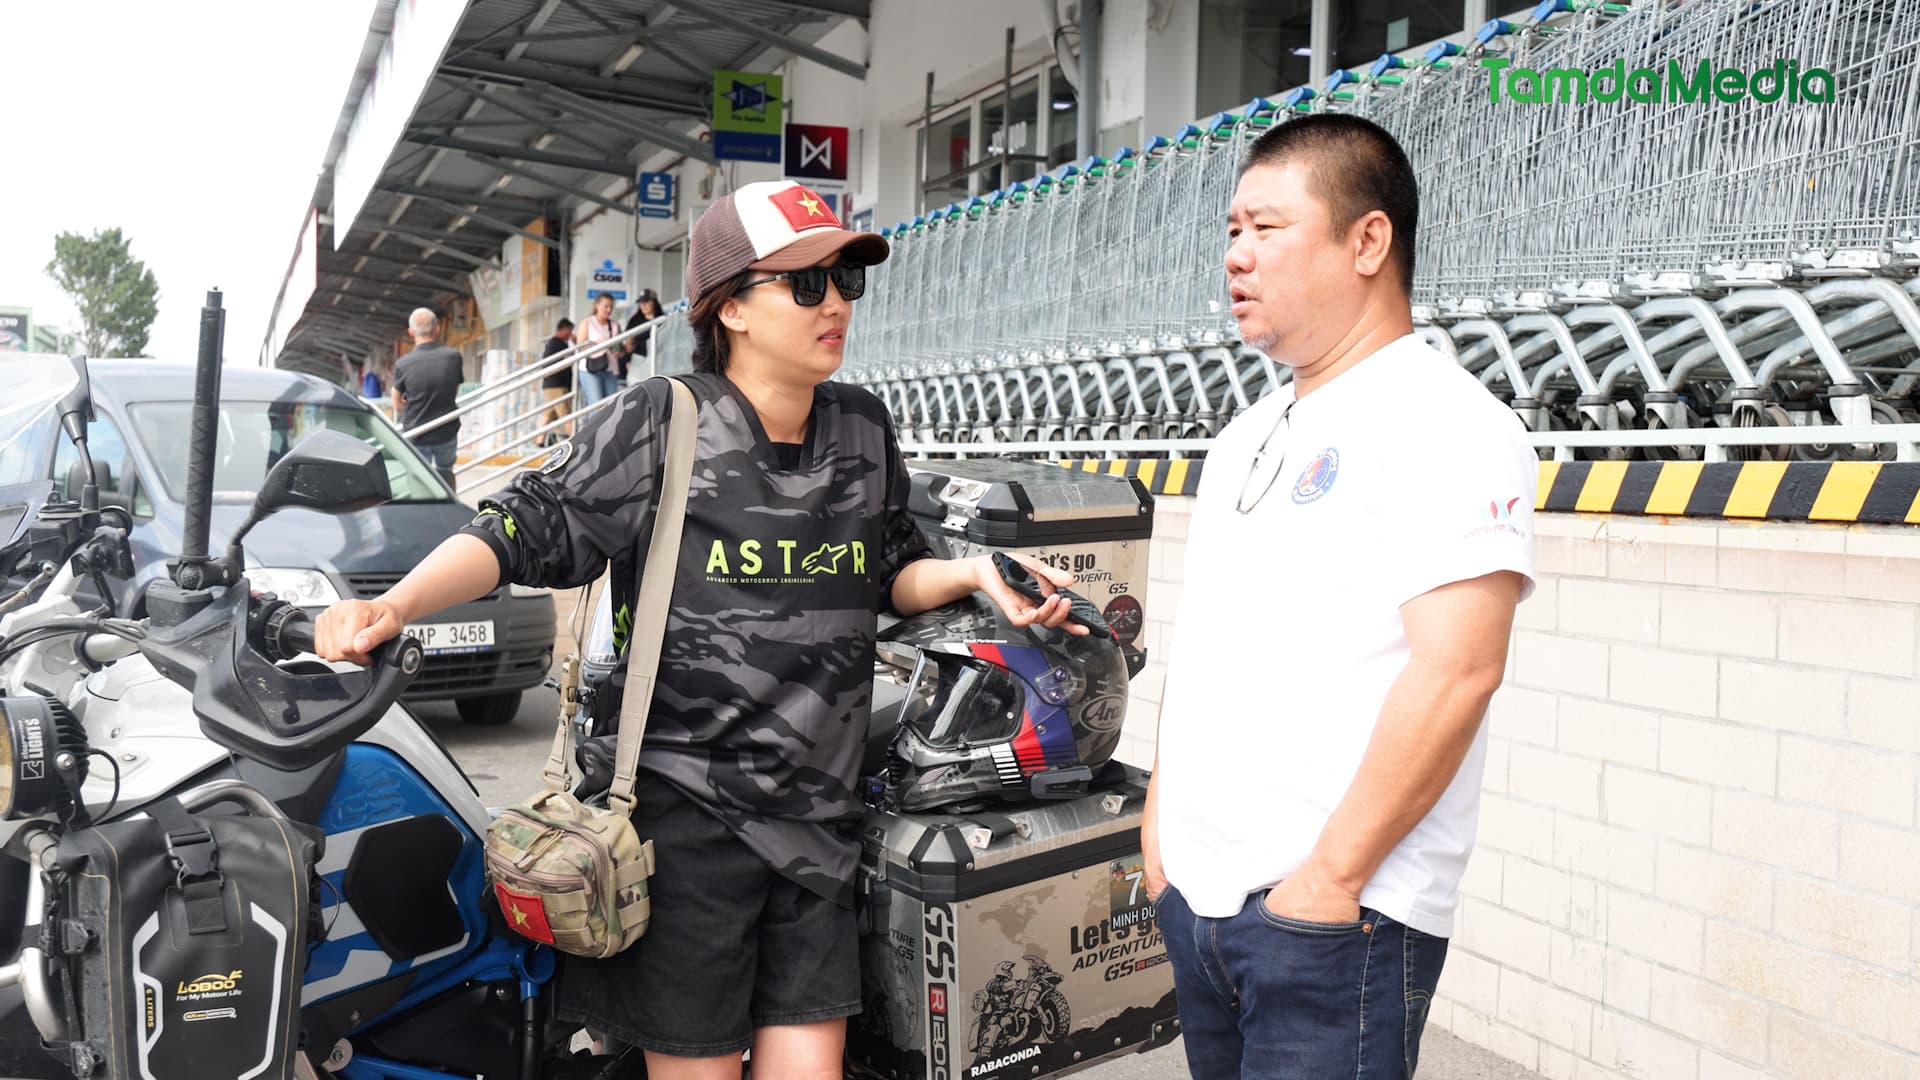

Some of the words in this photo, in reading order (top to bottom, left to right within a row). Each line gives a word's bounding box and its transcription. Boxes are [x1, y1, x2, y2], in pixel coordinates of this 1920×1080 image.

[1073, 553, 1096, 573] go
[1108, 582, 1129, 595] GS
[449, 624, 487, 644] 3458
[1087, 700, 1120, 721] Ara
[25, 718, 44, 759] LIGHTS
[1124, 870, 1144, 906] 7
[1112, 909, 1139, 929] MINH
[924, 902, 956, 984] GS
[1070, 918, 1131, 955] Lets
[1072, 933, 1164, 972] ADVENTUR
[1104, 958, 1136, 982] GS
[189, 993, 201, 1001] My
[228, 989, 242, 997] Life
[970, 1045, 1042, 1078] RABACONDA
